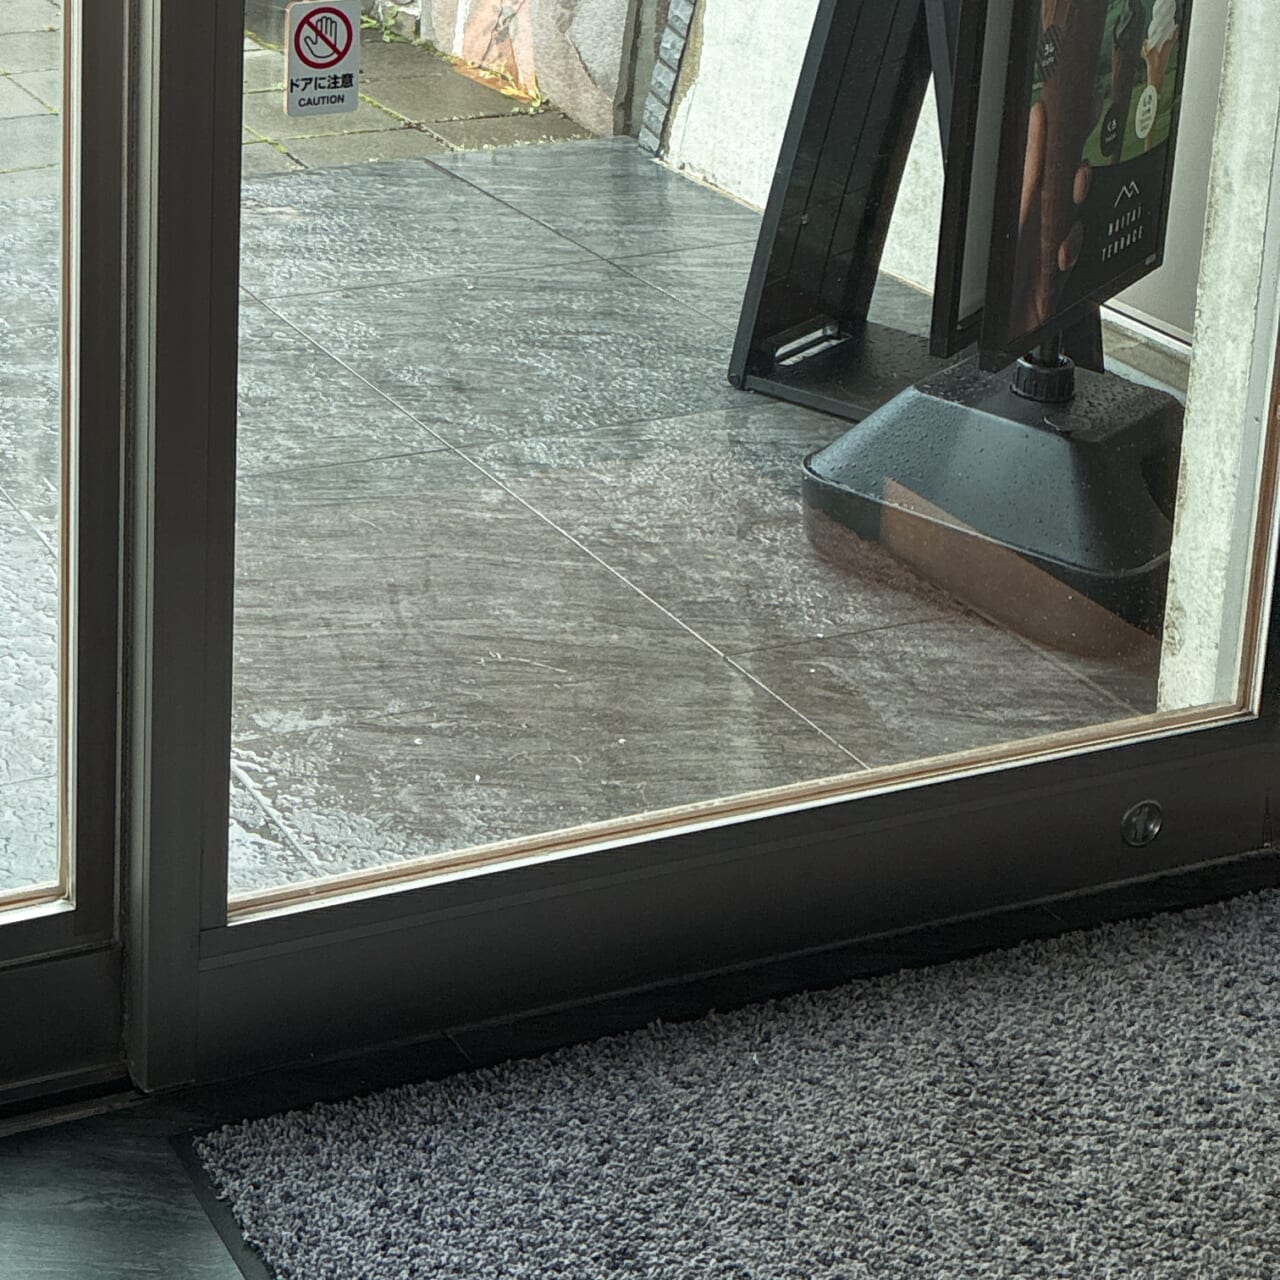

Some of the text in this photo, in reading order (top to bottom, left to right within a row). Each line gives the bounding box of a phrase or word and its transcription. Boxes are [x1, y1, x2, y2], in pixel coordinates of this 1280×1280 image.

[290, 73, 354, 93] ドアに注意
[298, 94, 345, 107] CAUTION
